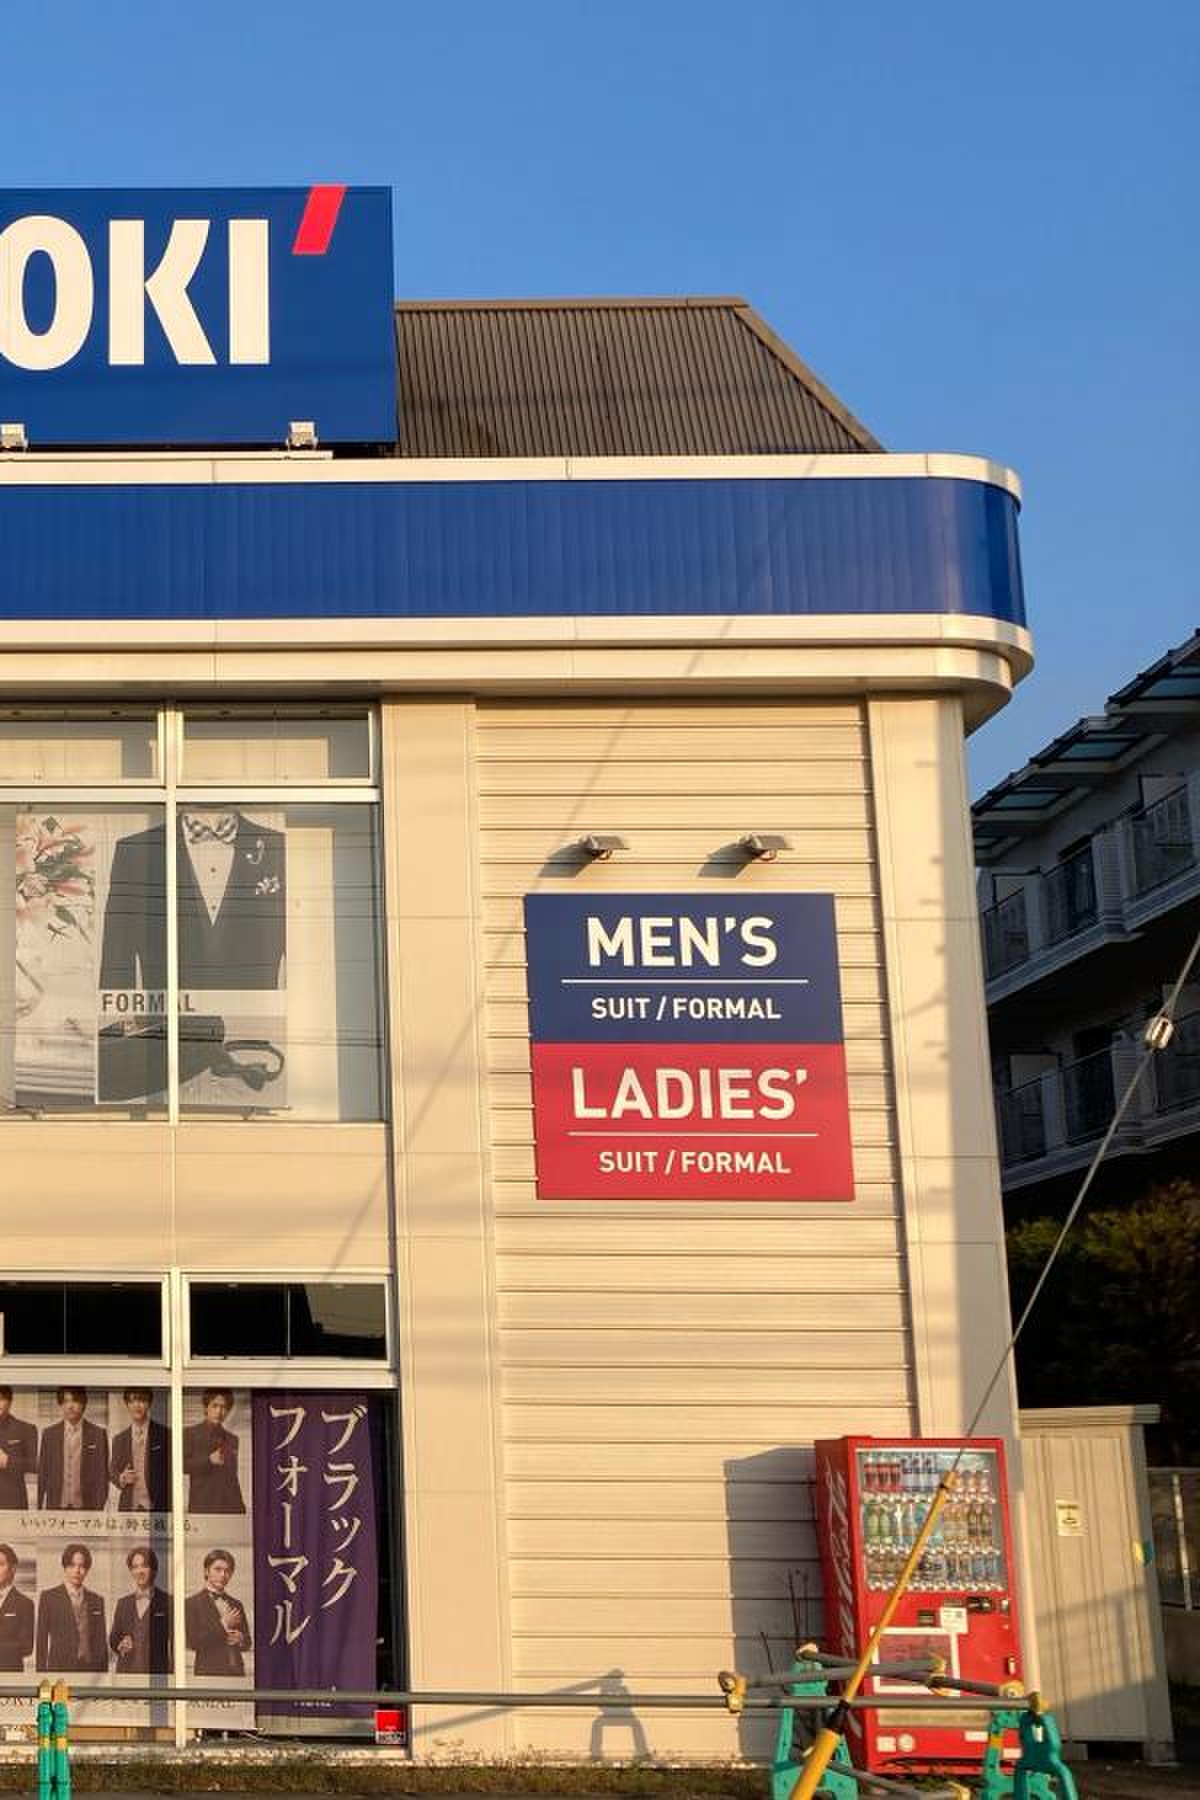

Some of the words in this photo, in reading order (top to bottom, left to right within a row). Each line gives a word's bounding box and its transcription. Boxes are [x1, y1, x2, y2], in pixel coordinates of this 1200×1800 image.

[587, 916, 779, 968] MEN'S
[102, 993, 195, 1012] FORML
[571, 1067, 808, 1120] LADIES'
[268, 1404, 311, 1647] フォーマル
[320, 1404, 368, 1609] ブラック
